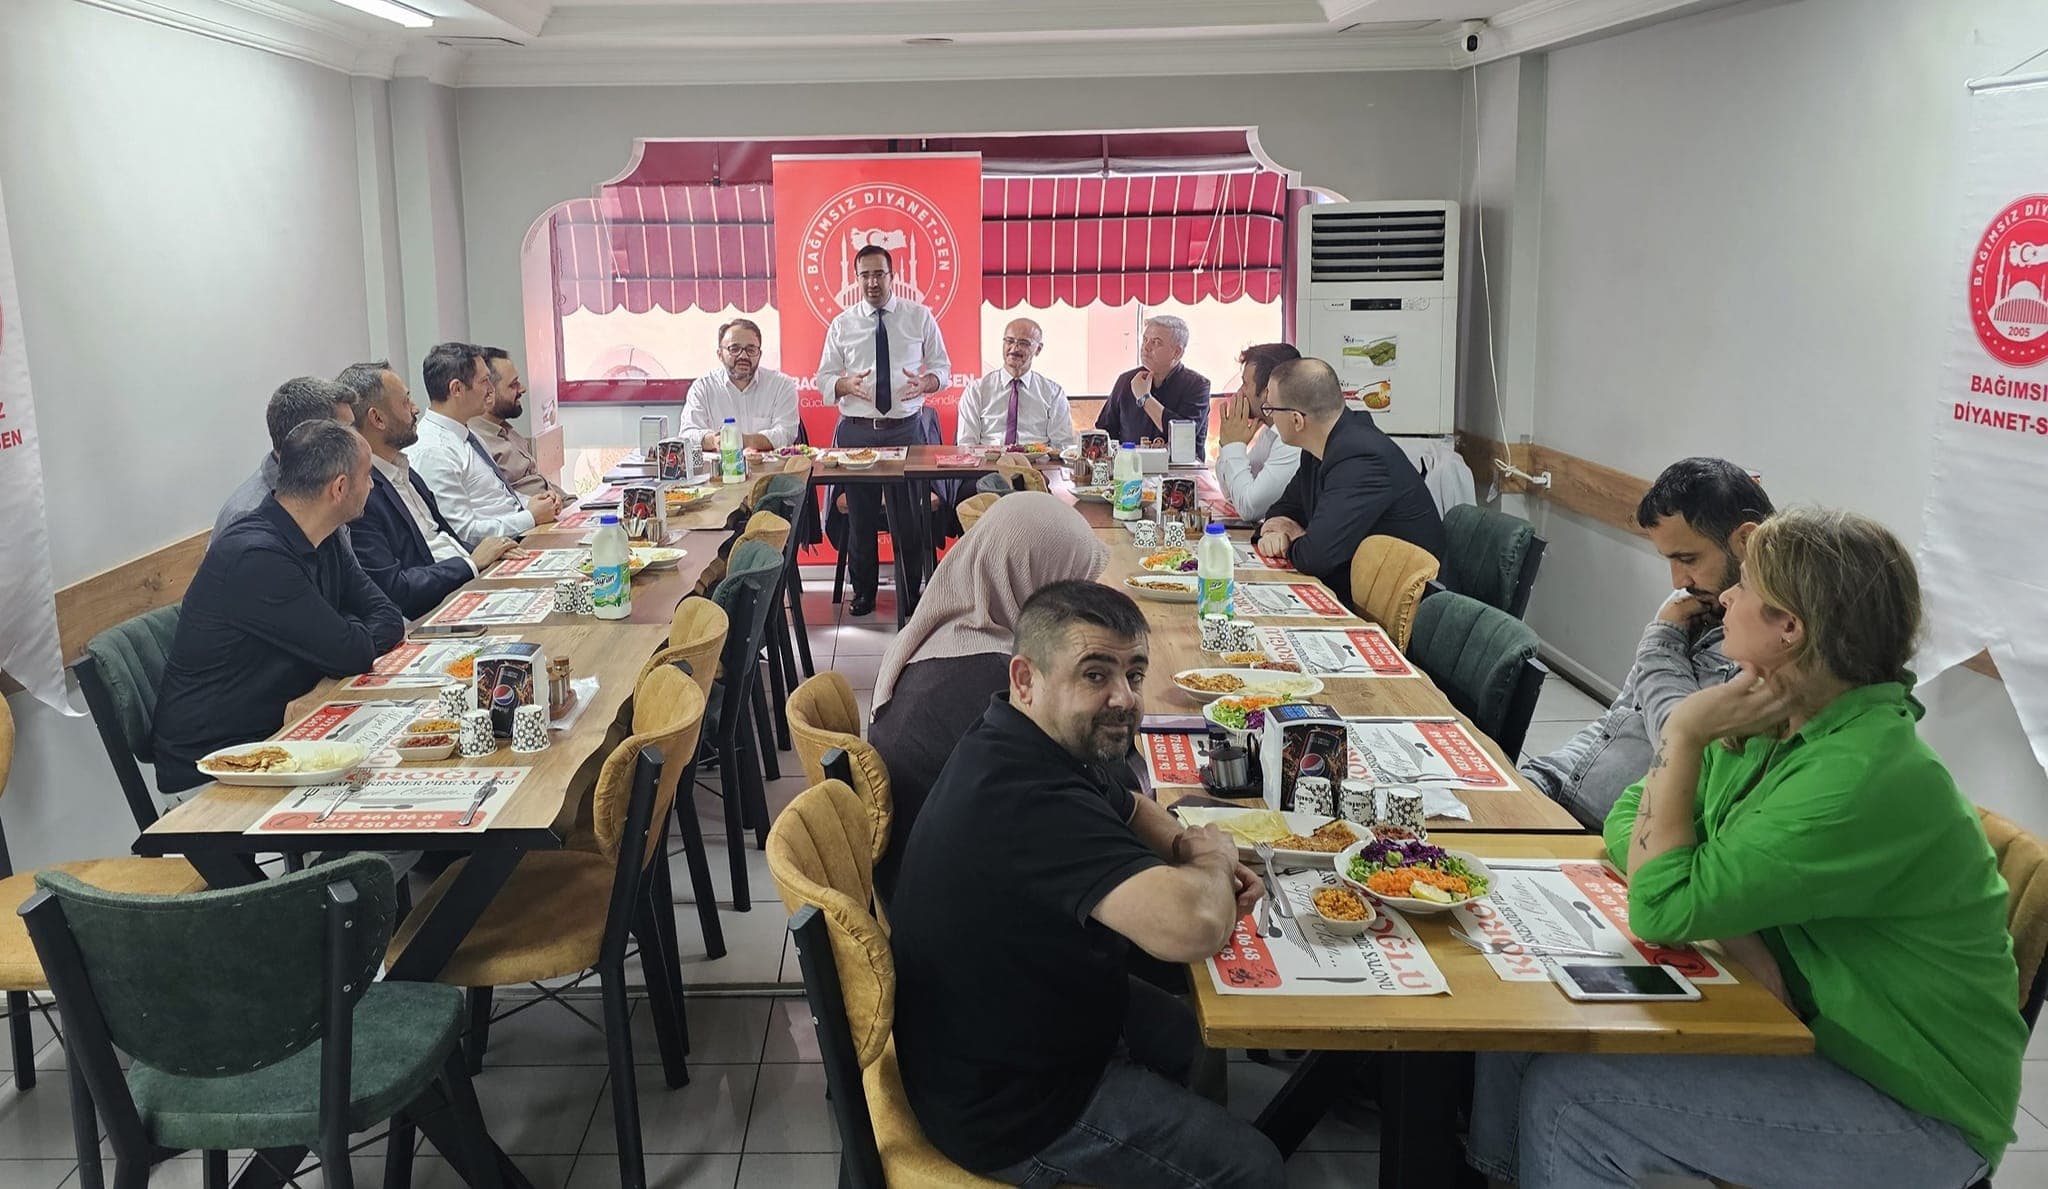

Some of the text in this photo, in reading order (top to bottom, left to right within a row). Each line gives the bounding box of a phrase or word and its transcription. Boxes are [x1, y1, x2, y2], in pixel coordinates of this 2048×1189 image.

[807, 188, 950, 274] BAĞIMSIZ DİYANET-SEN
[2008, 326, 2031, 337] 2005
[1970, 375, 2048, 402] BAĞIMSI
[1953, 401, 2048, 435] DİYANET-S
[0, 428, 23, 450] EN
[326, 813, 352, 821] 372
[1497, 906, 1541, 945] SKENDER
[1235, 933, 1255, 946] 06
[1367, 909, 1433, 989] OĞLU
[1241, 947, 1261, 961] 68
[1362, 951, 1397, 991] SALONU
